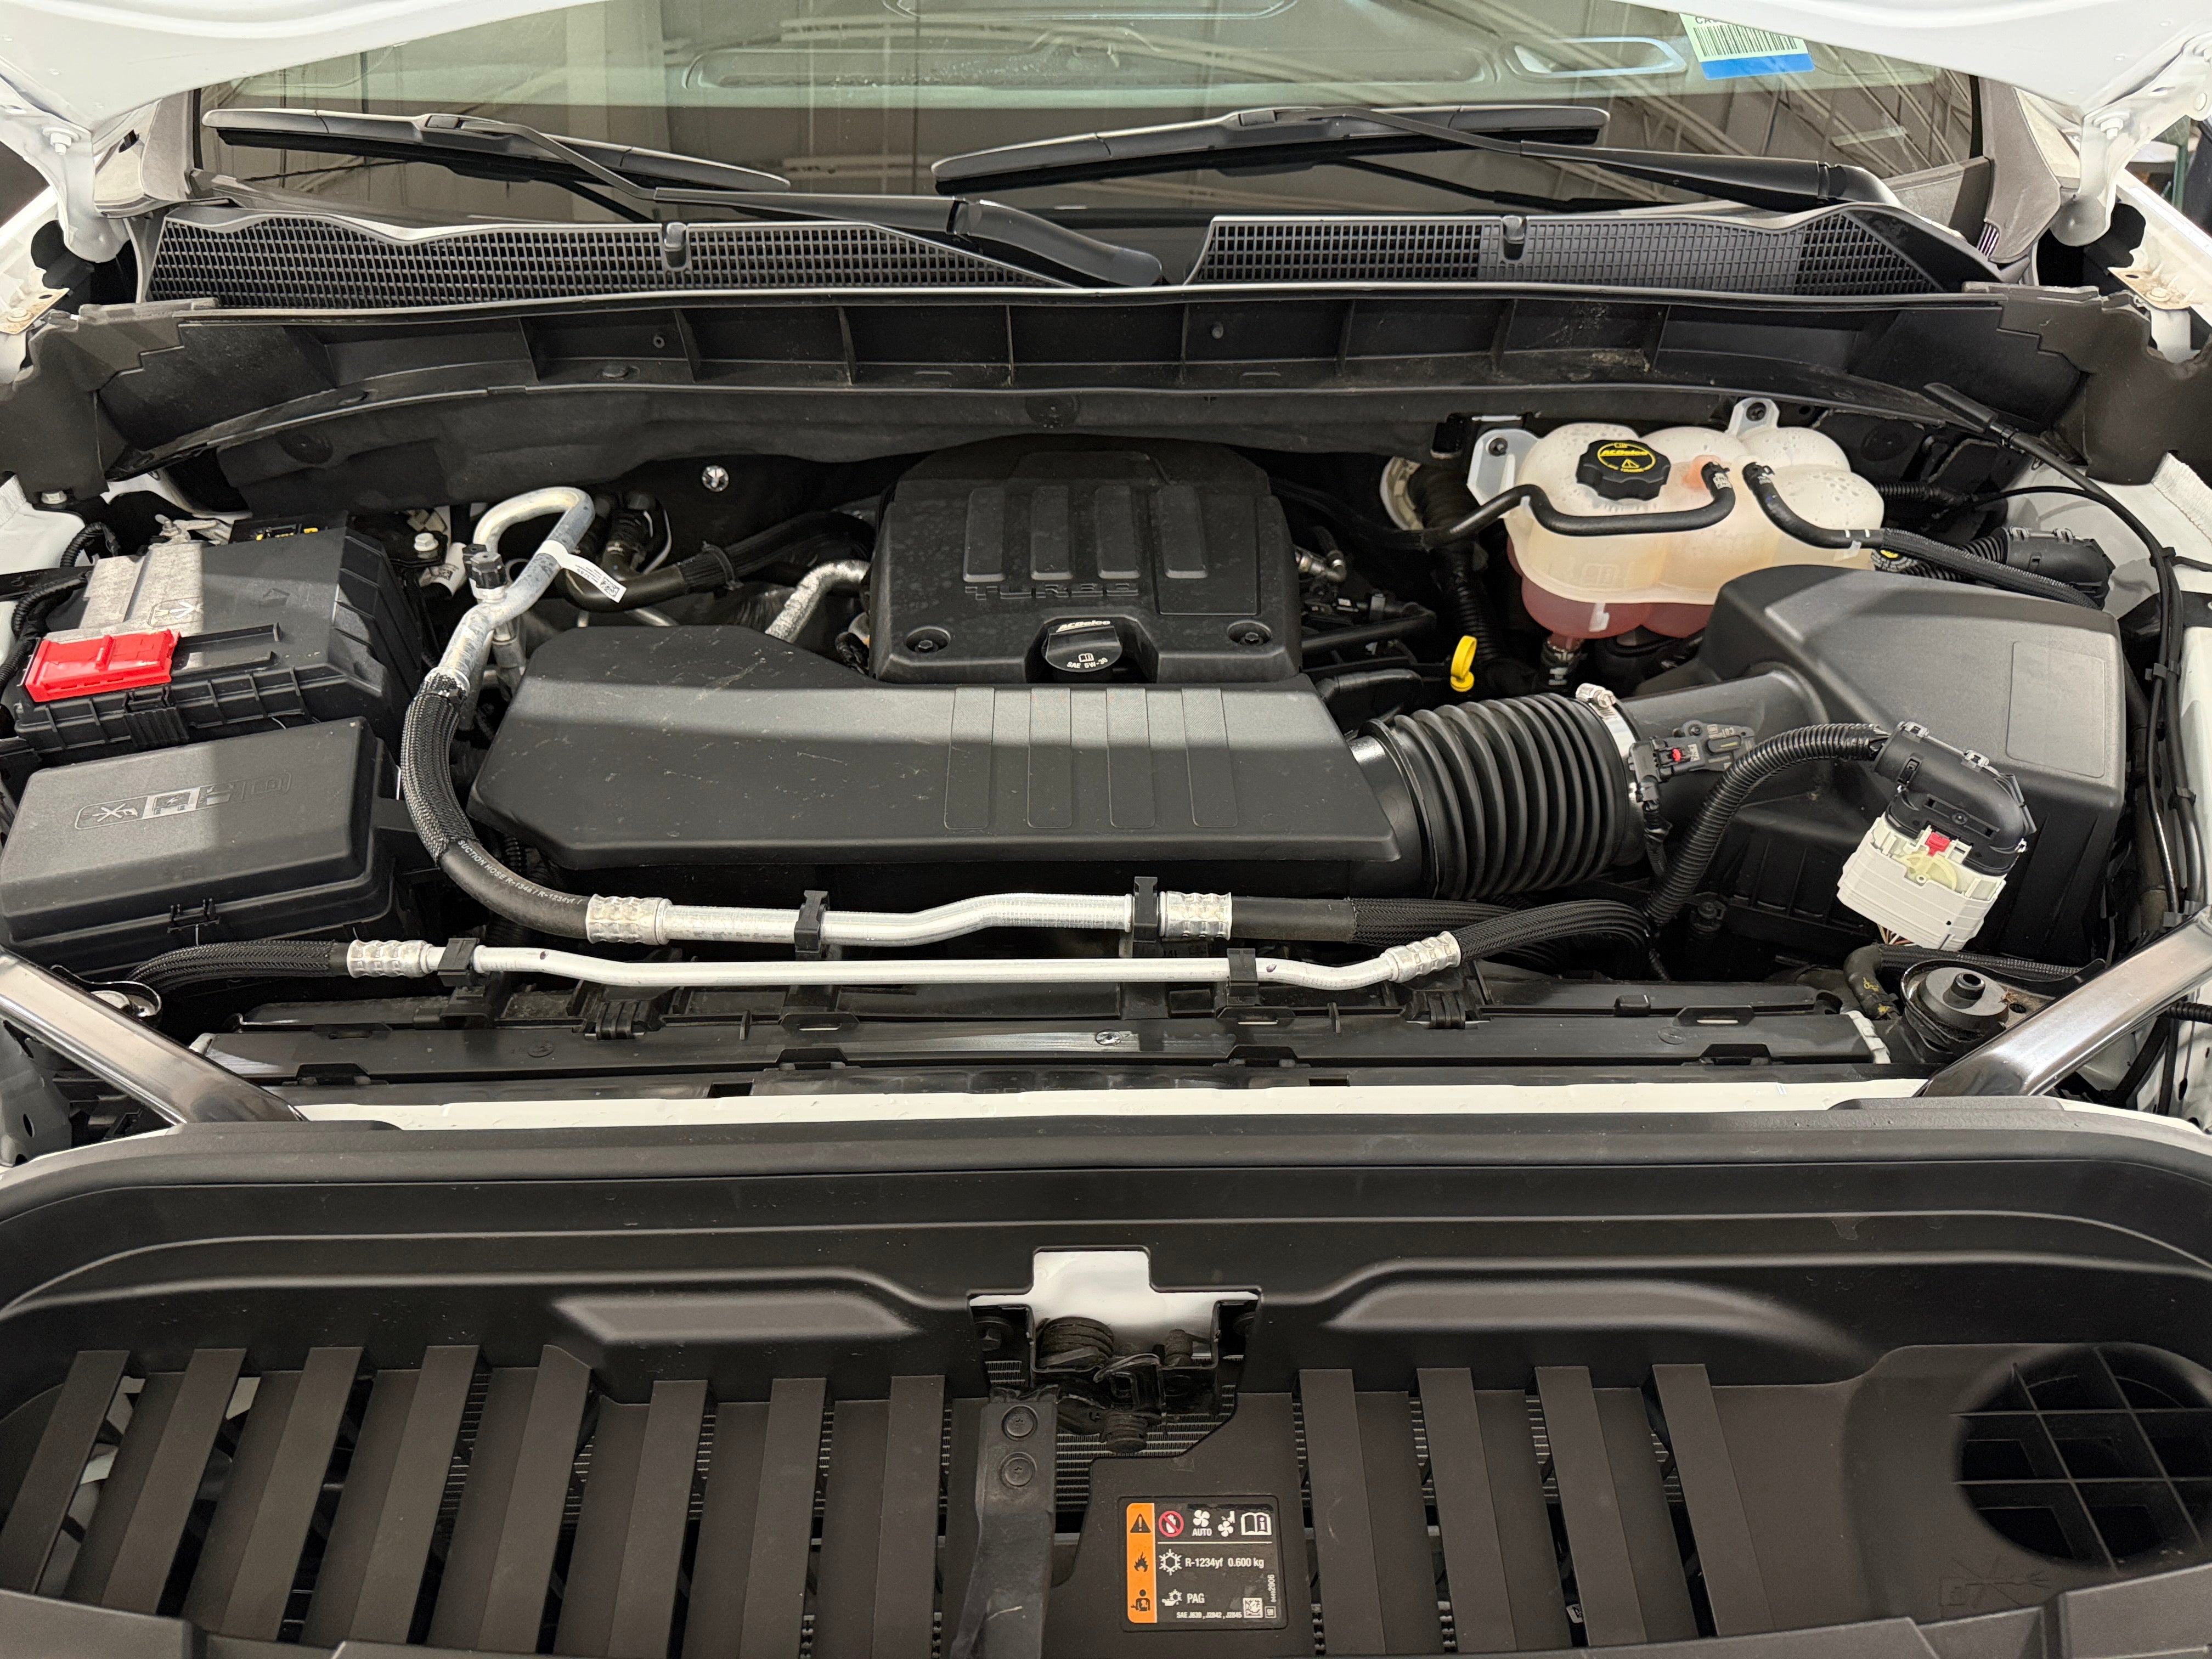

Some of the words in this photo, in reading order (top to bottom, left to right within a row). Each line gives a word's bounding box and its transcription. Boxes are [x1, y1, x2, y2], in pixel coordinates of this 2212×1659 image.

[1056, 620, 1110, 633] ACDelco
[1084, 657, 1108, 668] 5W-30
[458, 840, 487, 866] SUCTION
[484, 864, 507, 880] HOSE
[1192, 1528, 1212, 1536] AUTO
[1185, 1558, 1223, 1569] R-1234yf
[1228, 1558, 1251, 1567] 0.600
[1254, 1557, 1265, 1569] kg
[1187, 1593, 1205, 1604] PAG
